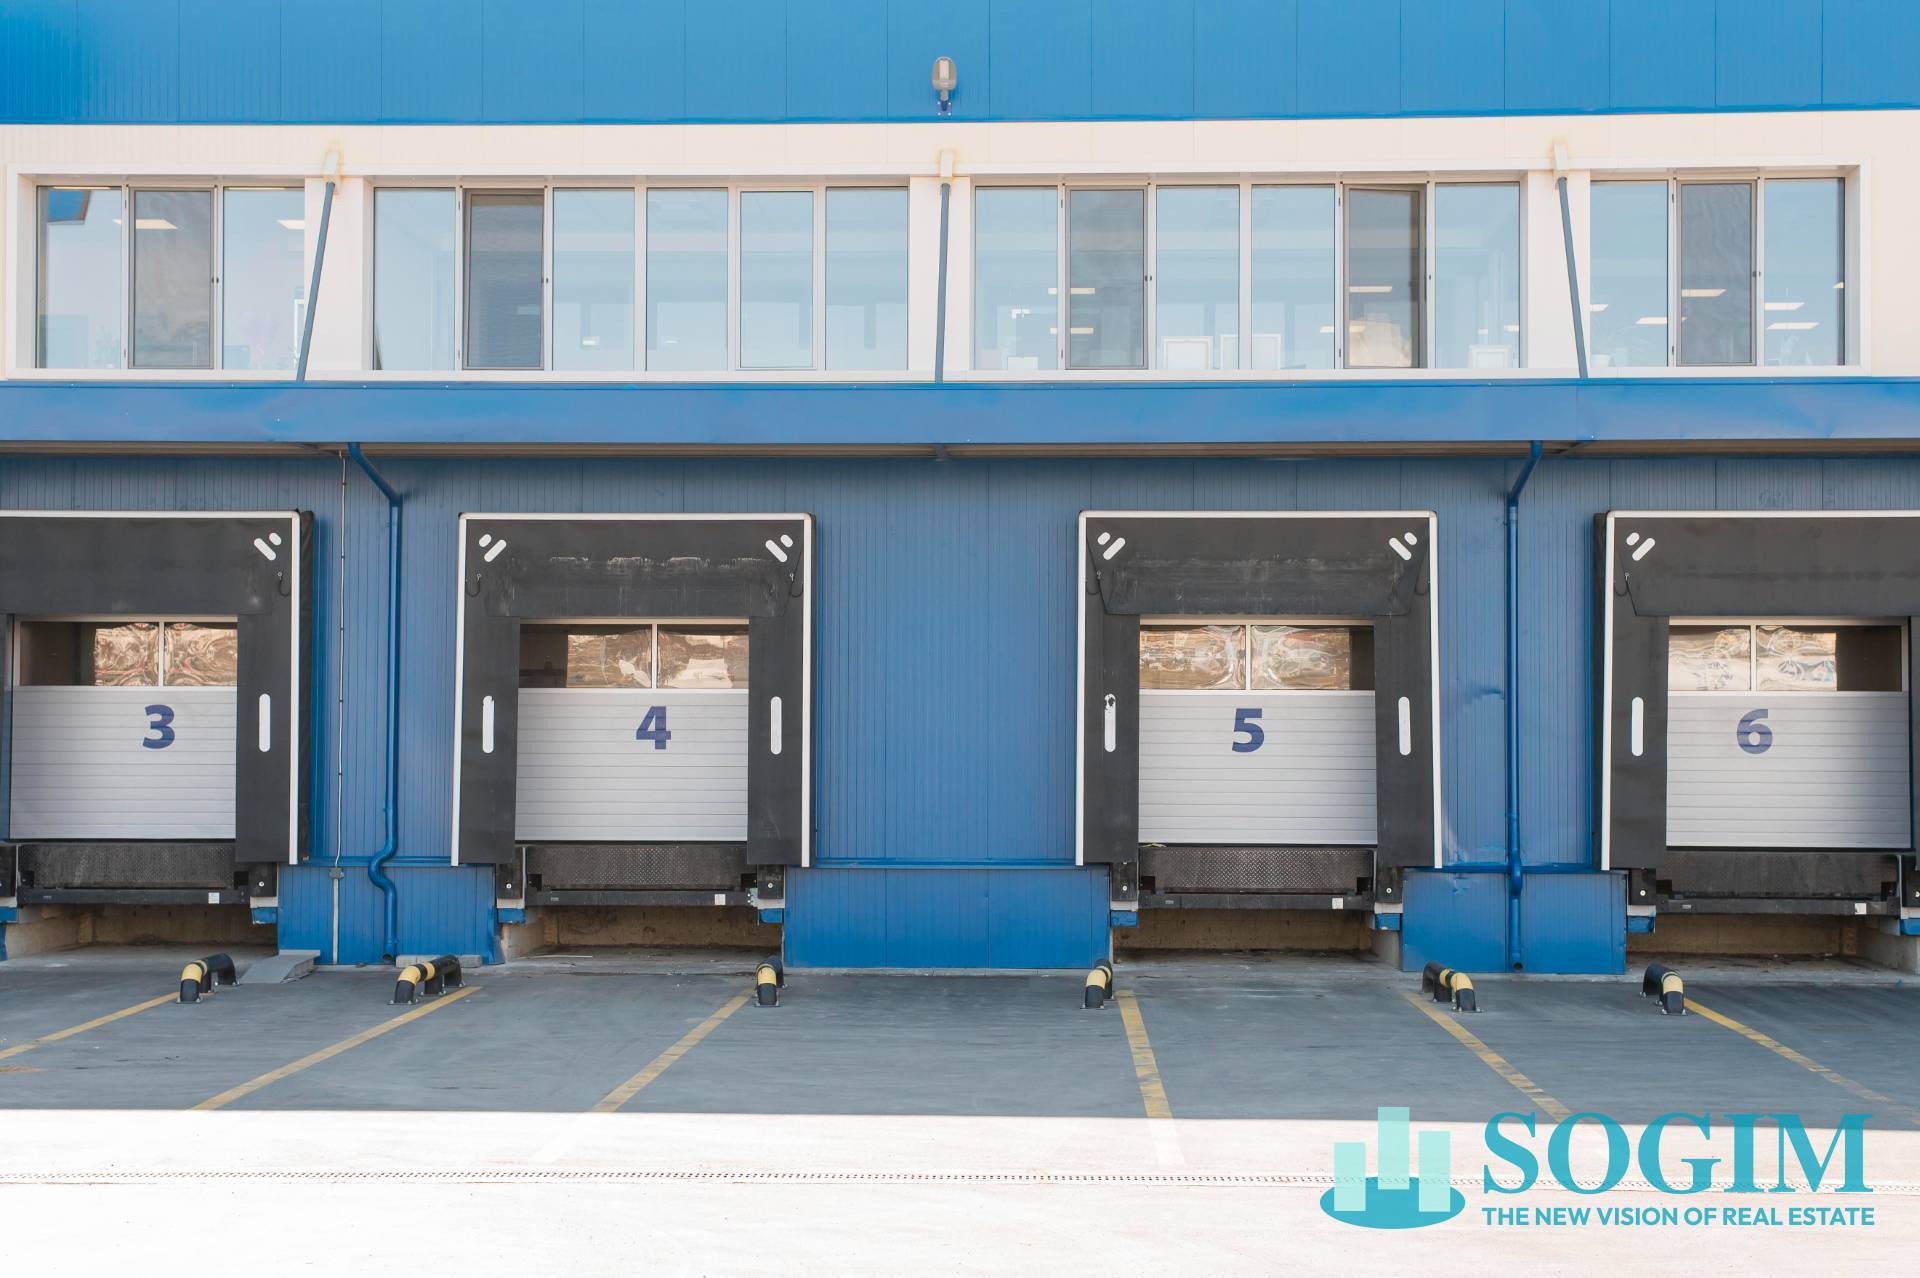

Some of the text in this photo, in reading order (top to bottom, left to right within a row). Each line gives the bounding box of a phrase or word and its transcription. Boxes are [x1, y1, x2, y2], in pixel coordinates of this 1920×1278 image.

[143, 704, 175, 748] 3
[635, 706, 672, 750] 4
[1232, 707, 1264, 753] 5
[1736, 708, 1773, 755] 6
